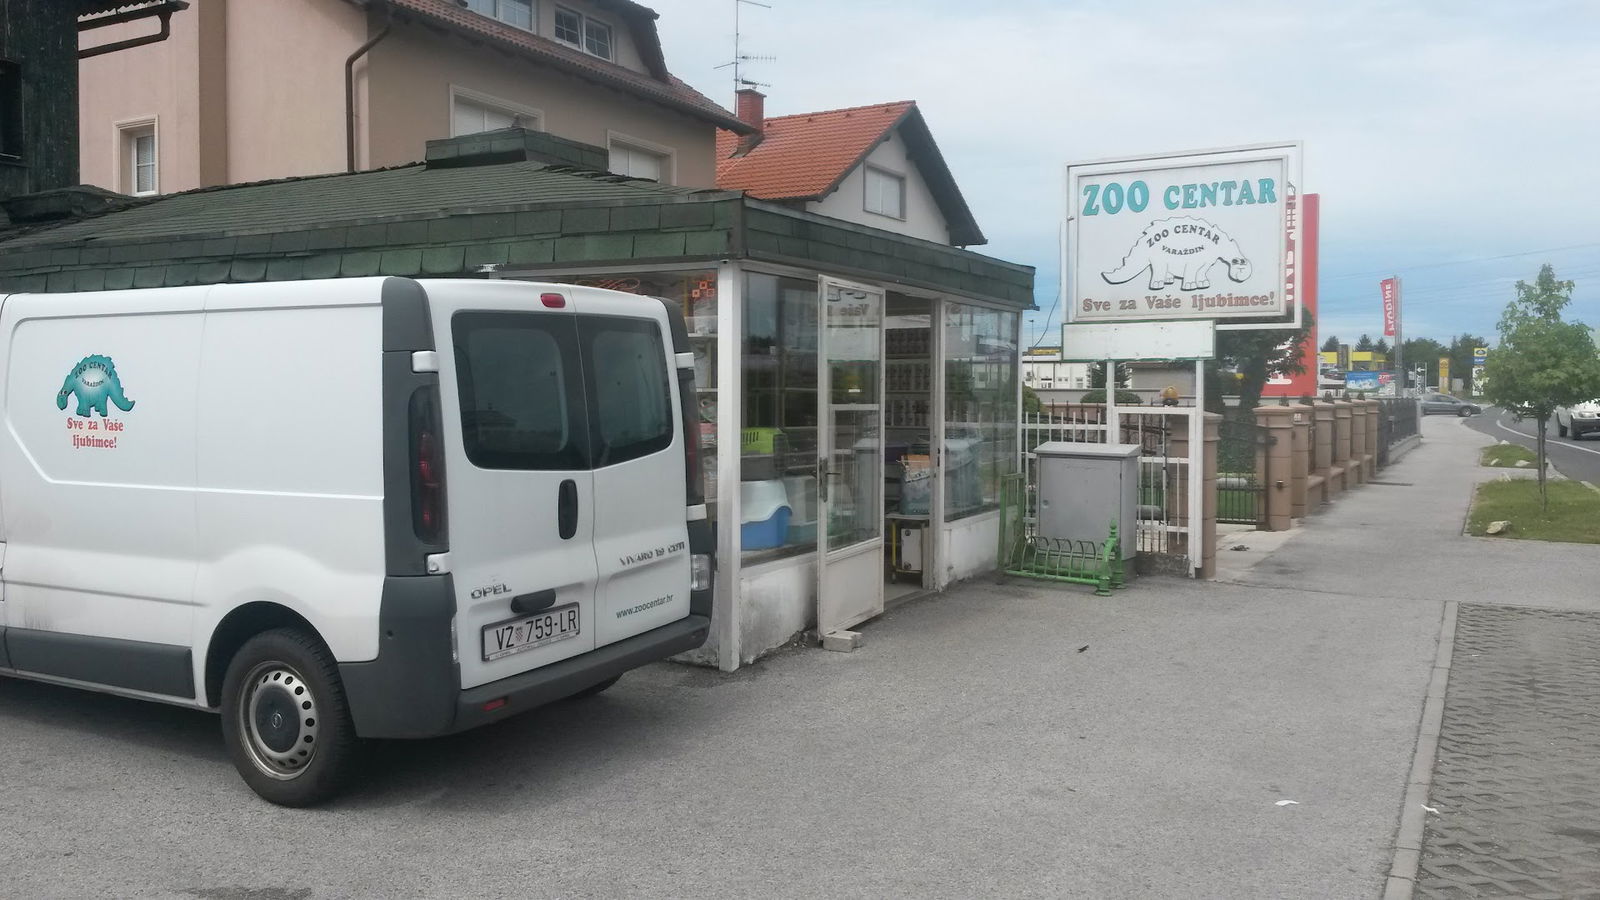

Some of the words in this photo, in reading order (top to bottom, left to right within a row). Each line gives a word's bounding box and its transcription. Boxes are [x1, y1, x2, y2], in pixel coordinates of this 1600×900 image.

[1083, 180, 1150, 216] ZOO
[1163, 178, 1277, 211] CENTAR
[1146, 229, 1169, 248] ZOO
[1174, 224, 1220, 245] CENTAR
[1162, 245, 1204, 255] VARAŽDIN
[1083, 298, 1111, 312] Sve
[1119, 299, 1137, 311] za
[1145, 294, 1181, 310] Vaše
[1191, 291, 1275, 312] ljubimce!
[89, 361, 113, 380] CENTAR
[67, 417, 83, 430] Sve
[88, 421, 98, 430] za
[103, 418, 123, 431] Vaše
[73, 434, 117, 449] ljubimce!
[470, 583, 512, 600] OPEL
[616, 594, 674, 619] www.zoocentar.hr
[496, 626, 515, 650] VZ
[525, 609, 577, 643] 759-LR
